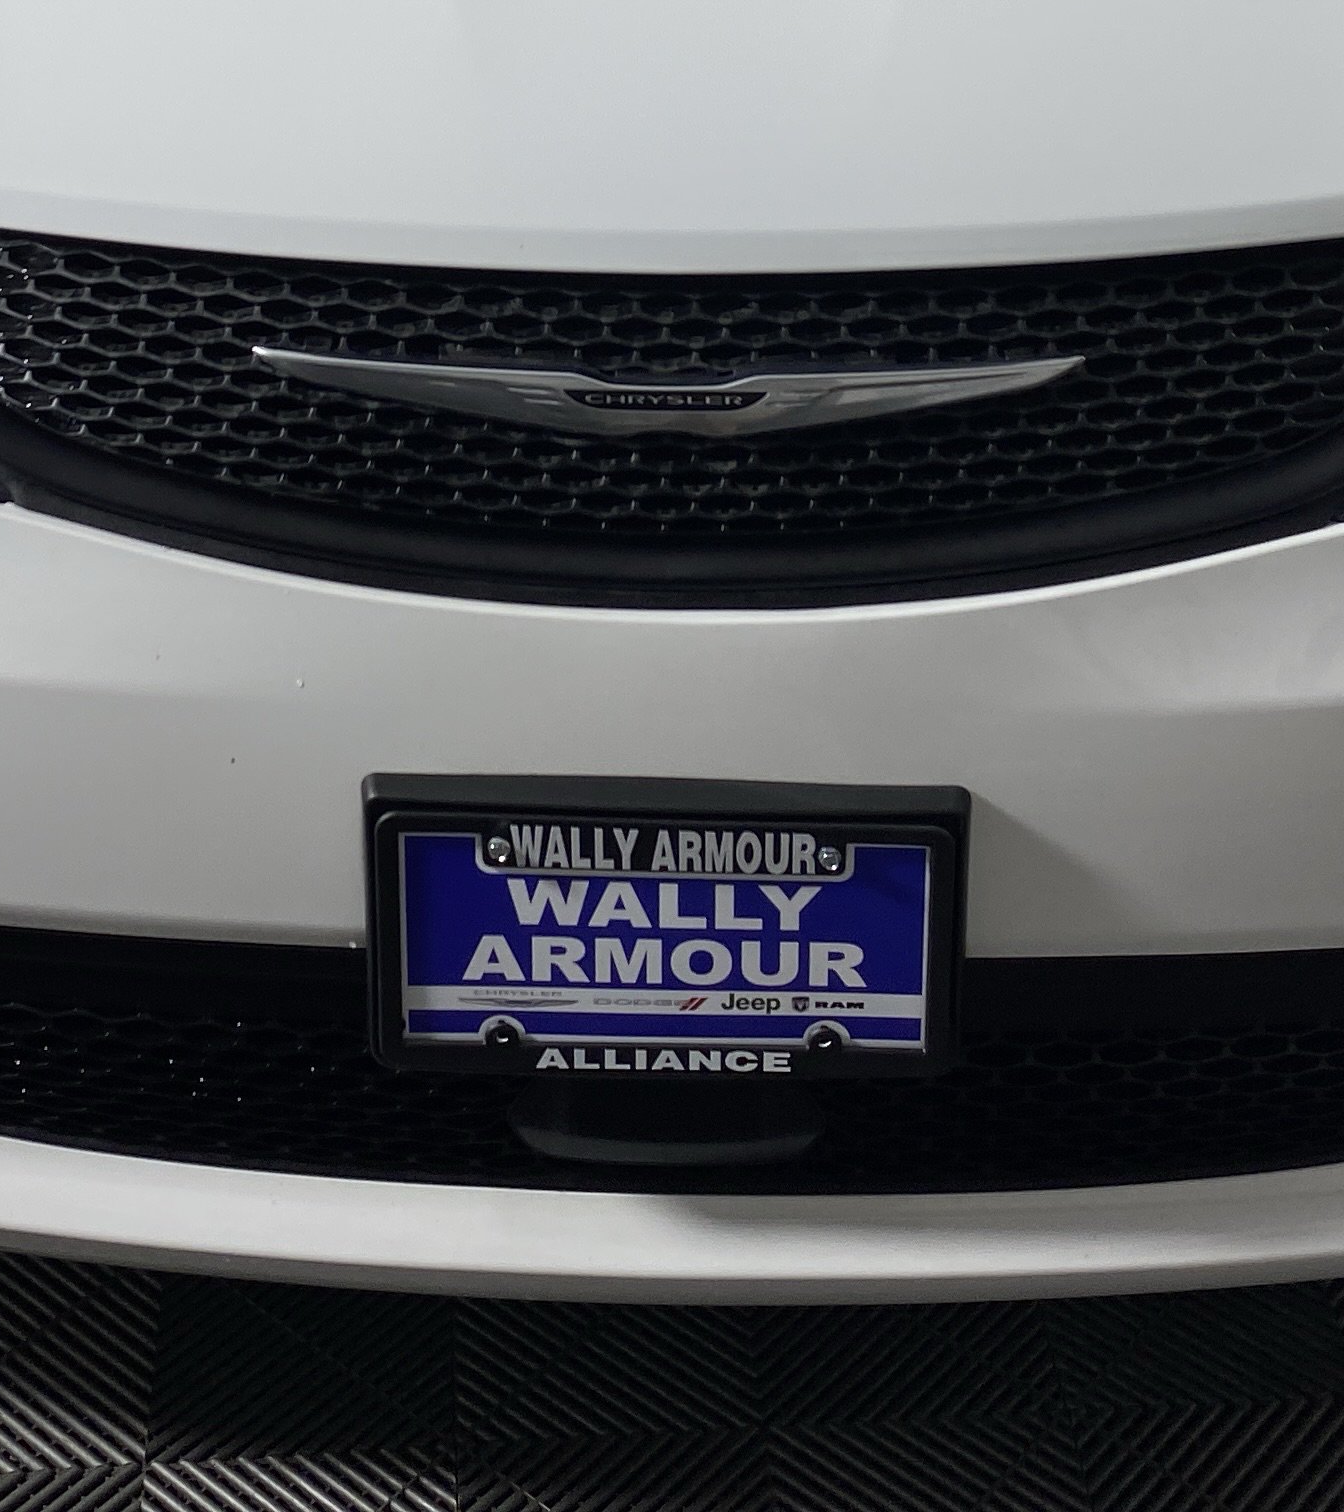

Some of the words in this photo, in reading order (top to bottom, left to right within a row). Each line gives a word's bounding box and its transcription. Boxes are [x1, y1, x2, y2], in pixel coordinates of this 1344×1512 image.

[585, 393, 744, 406] CHRYSLER
[509, 824, 639, 872] WALLY
[652, 828, 817, 875] ARMOUR
[506, 877, 822, 931] WALLY
[462, 934, 867, 988] ARMOUR
[721, 993, 781, 1014] Jeep
[815, 1001, 865, 1010] RAM
[536, 1047, 792, 1073] ALLIANCE
